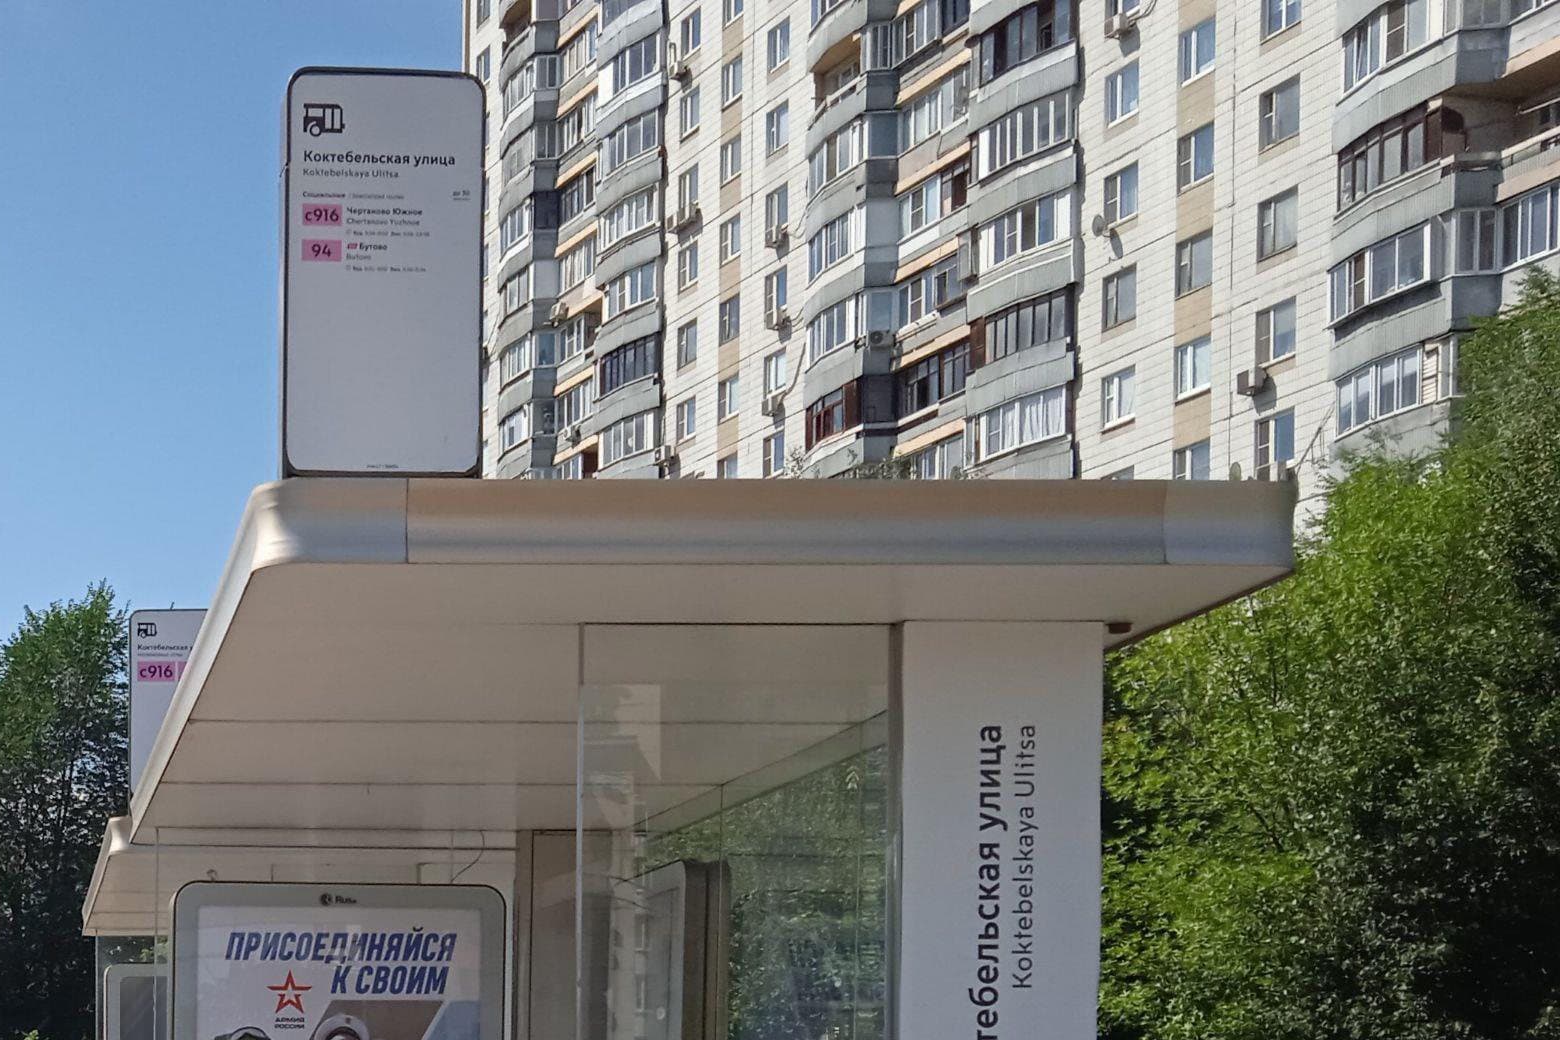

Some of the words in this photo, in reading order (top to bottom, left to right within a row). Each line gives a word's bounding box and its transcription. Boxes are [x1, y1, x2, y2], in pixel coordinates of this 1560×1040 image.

[303, 150, 410, 165] Коктебельская
[413, 154, 456, 167] улица
[302, 168, 370, 178] Koktebelskaya
[372, 169, 399, 178] Ulitsa
[305, 208, 340, 222] с916
[311, 243, 332, 258] 94
[139, 665, 173, 678] с916
[1013, 724, 1036, 797] Ulitsa
[978, 724, 1007, 832] улица
[1011, 806, 1039, 989] Koktebelskaya
[225, 926, 458, 964] ПРИСОЕДИНЯЙСЯ
[330, 965, 352, 994] К
[355, 965, 449, 994] СВОИМ
